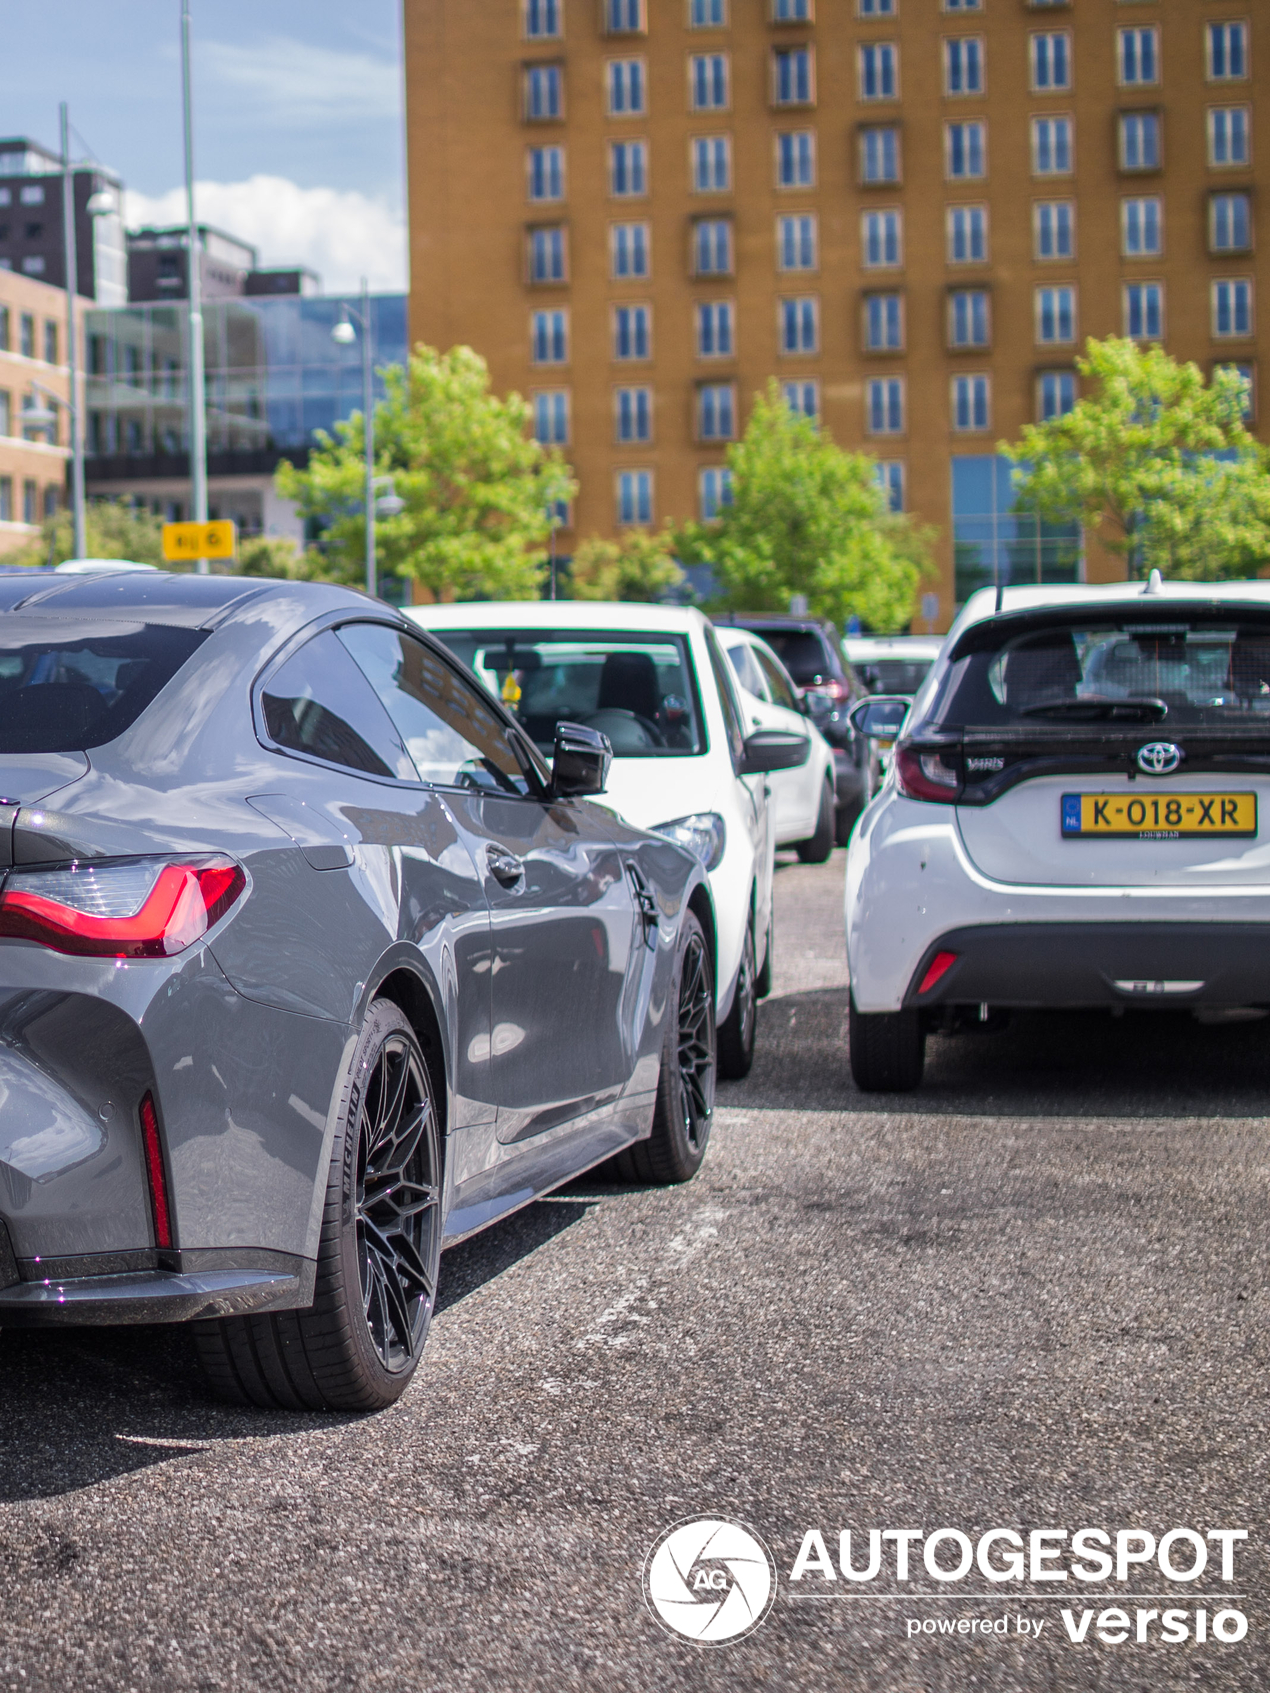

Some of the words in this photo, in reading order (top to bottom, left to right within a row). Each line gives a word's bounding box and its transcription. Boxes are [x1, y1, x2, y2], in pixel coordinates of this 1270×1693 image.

[1065, 816, 1080, 828] NL
[1094, 798, 1239, 826] K-018-XR
[342, 1085, 360, 1195] MICHELIN
